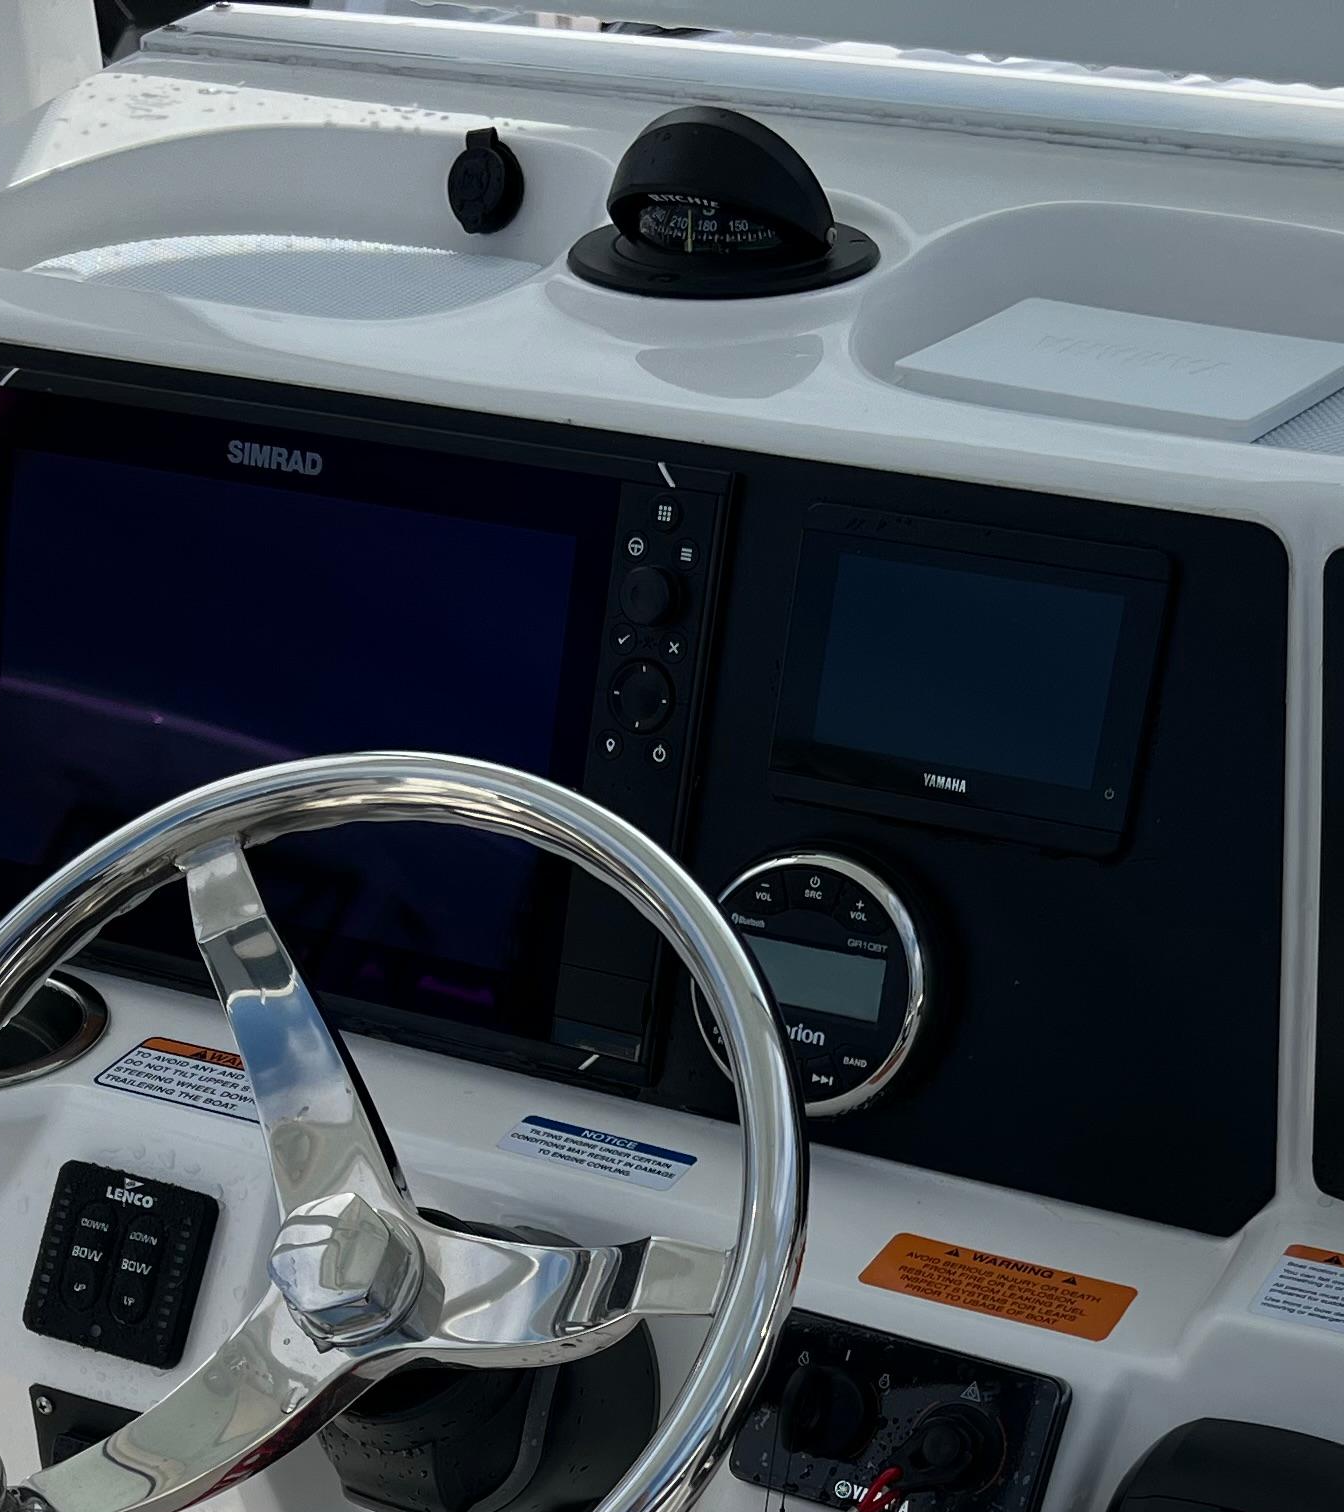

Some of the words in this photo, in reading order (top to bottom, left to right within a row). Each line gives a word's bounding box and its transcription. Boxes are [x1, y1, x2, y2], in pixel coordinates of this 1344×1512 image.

[669, 215, 689, 229] 210
[697, 219, 718, 232] 180
[728, 219, 750, 232] 150
[226, 440, 323, 476] SIMRAD
[923, 772, 966, 793] YAMAHA
[755, 891, 772, 902] VOL
[804, 889, 823, 900] SRC
[850, 911, 868, 922] VOL
[123, 1058, 144, 1067] DO
[144, 1063, 171, 1073] NOT
[172, 1069, 198, 1079] TILT
[198, 1075, 240, 1090] UPPER
[135, 1050, 152, 1059] TO
[152, 1055, 190, 1067] AVOID
[190, 1064, 217, 1074] ANY
[217, 1070, 245, 1080] AND
[843, 1056, 868, 1068] BAND
[105, 1073, 176, 1095] TRAILERING
[178, 1090, 203, 1102] THE
[202, 1098, 238, 1110] BOAT.
[114, 1066, 174, 1084] STEERING
[176, 1080, 216, 1095] WHEEL
[530, 1128, 563, 1141] TILTING
[563, 1137, 598, 1150] ENGINE
[599, 1146, 631, 1158] UNDER
[632, 1155, 672, 1169] CERTAIN
[581, 1130, 638, 1149] NOTICE
[511, 1132, 565, 1150] CONDITIONS
[566, 1147, 587, 1155] MAY
[587, 1152, 623, 1165] RESULT
[634, 1164, 675, 1179] DAMAGE
[551, 1152, 586, 1165] ENGINE
[586, 1161, 630, 1176] COWLING
[106, 1186, 154, 1209] LENCO
[81, 1217, 109, 1233] DOWN
[129, 1231, 158, 1246] DOWN
[71, 1245, 103, 1262] BOW
[121, 1258, 152, 1275] BOW
[972, 1252, 1054, 1279] WARNING
[73, 1282, 86, 1292] UP
[898, 1265, 963, 1286] RESULTING
[964, 1282, 1001, 1295] FROM
[1001, 1291, 1053, 1308] LEAKING
[1054, 1304, 1086, 1316] FUEL
[906, 1252, 941, 1264] AVOID
[942, 1261, 994, 1277] SERIOUS
[996, 1273, 1034, 1287] INJURY
[1040, 1284, 1059, 1293] OR
[1060, 1289, 1102, 1303] DEATH
[922, 1263, 957, 1276] FROM
[958, 1272, 986, 1283] FIRE
[987, 1280, 1006, 1288] OR
[1007, 1284, 1077, 1305] EXPLOSION
[900, 1274, 951, 1290] INSPECT
[951, 1287, 1009, 1305] SYSTEMS
[1010, 1301, 1036, 1311] FOR
[1038, 1308, 1077, 1322] LEAKS
[904, 1283, 942, 1296] PRIOR
[945, 1292, 961, 1301] TO
[962, 1298, 1005, 1312] USAGE
[1006, 1308, 1025, 1317] OF
[1025, 1313, 1059, 1325] BOAT
